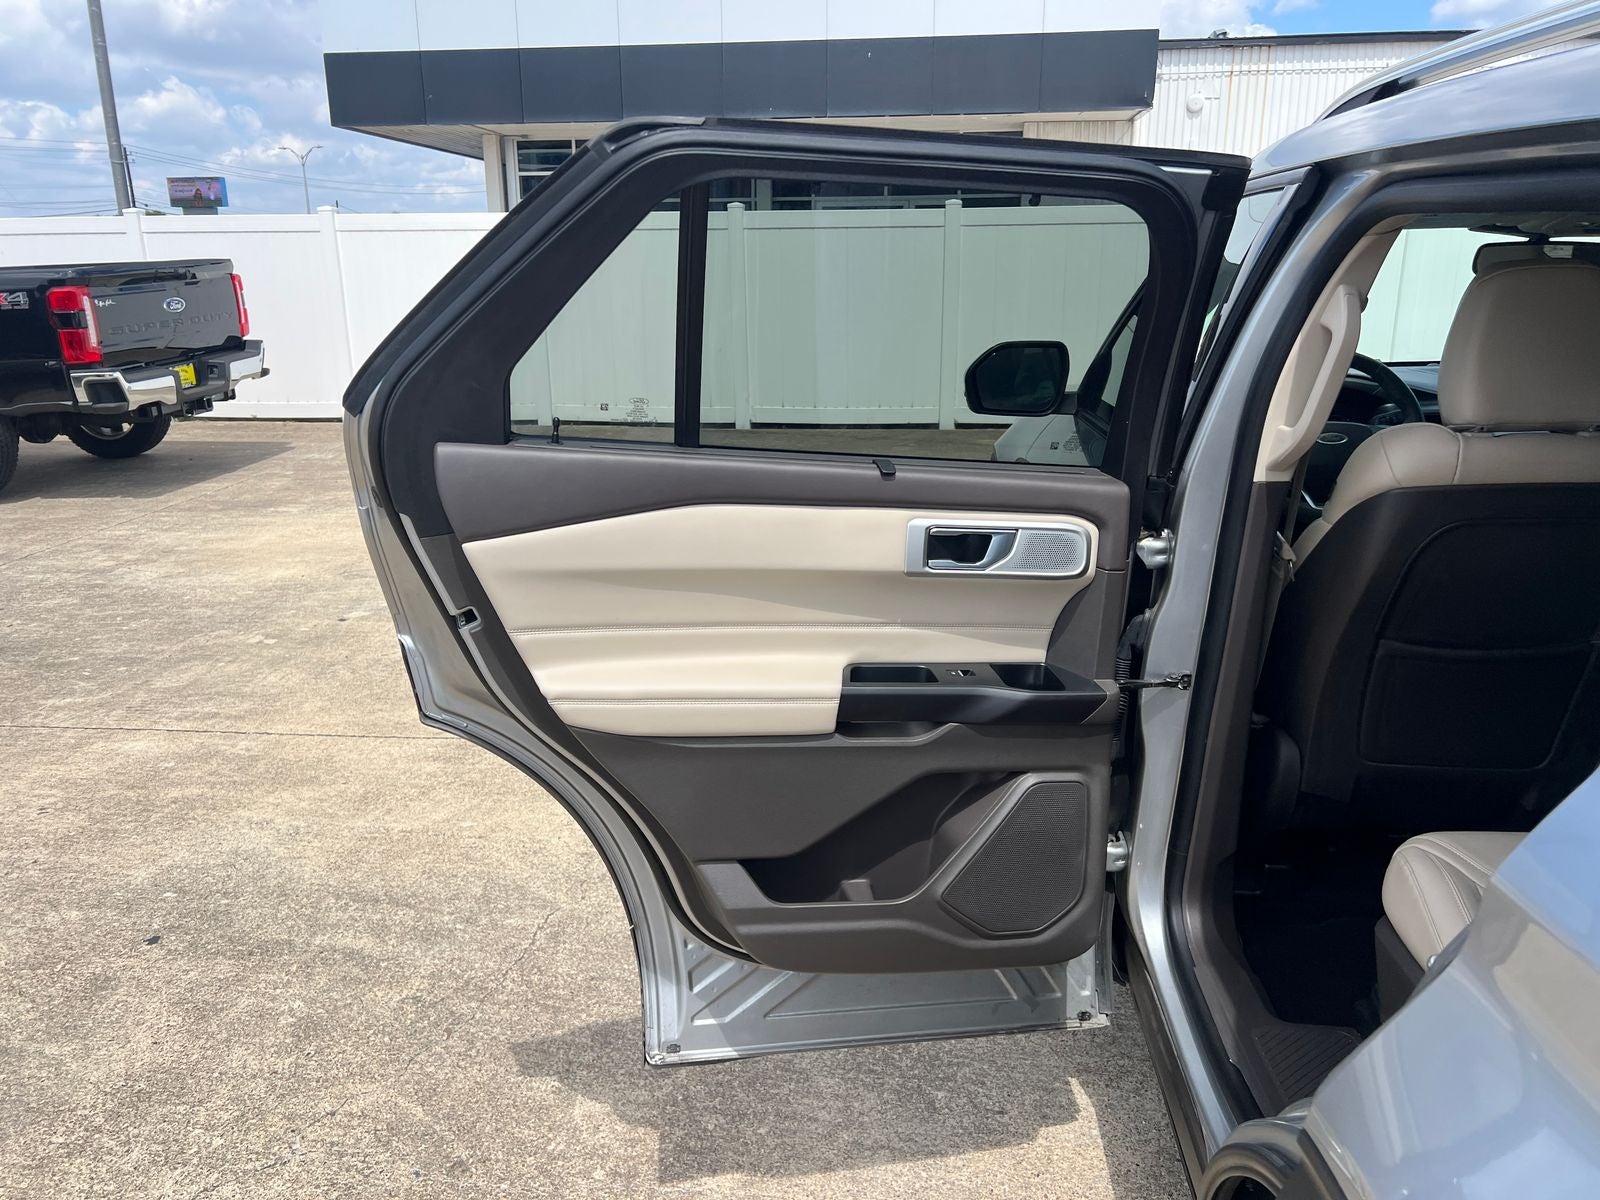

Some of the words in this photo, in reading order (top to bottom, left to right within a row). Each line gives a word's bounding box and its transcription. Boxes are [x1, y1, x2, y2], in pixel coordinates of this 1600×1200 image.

[165, 299, 184, 311] Ford
[108, 318, 184, 335] SUPER
[190, 311, 233, 324] DUTY
